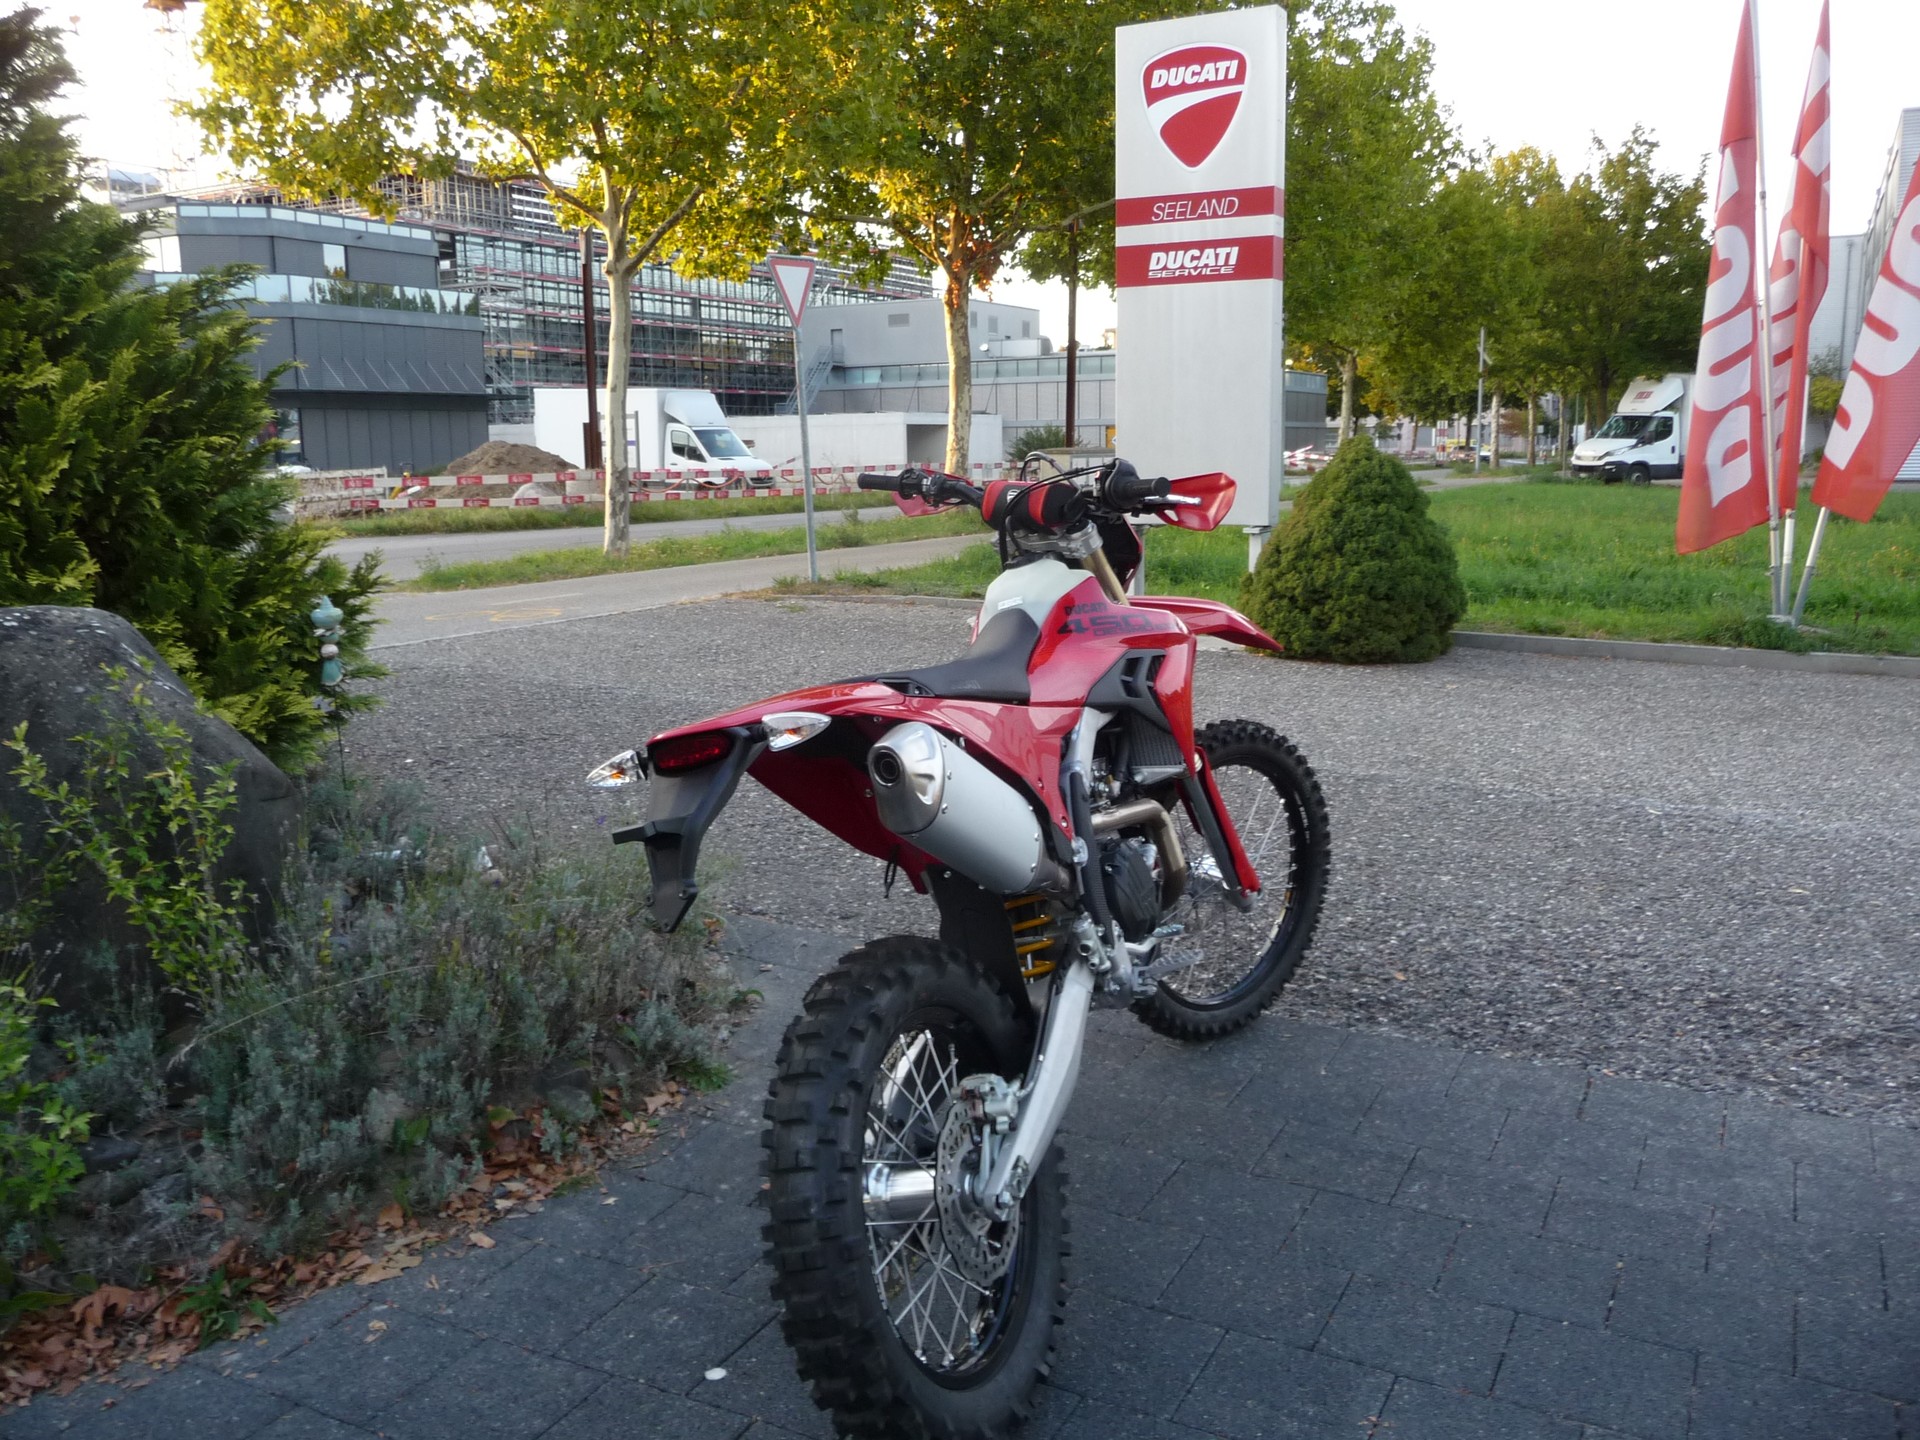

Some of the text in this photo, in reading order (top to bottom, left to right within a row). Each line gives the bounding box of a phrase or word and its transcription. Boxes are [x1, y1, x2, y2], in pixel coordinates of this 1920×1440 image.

[1150, 59, 1239, 89] DUCATI
[1151, 196, 1239, 222] SEELAND
[1148, 246, 1240, 271] DUCATI
[1147, 265, 1236, 279] SERVICE
